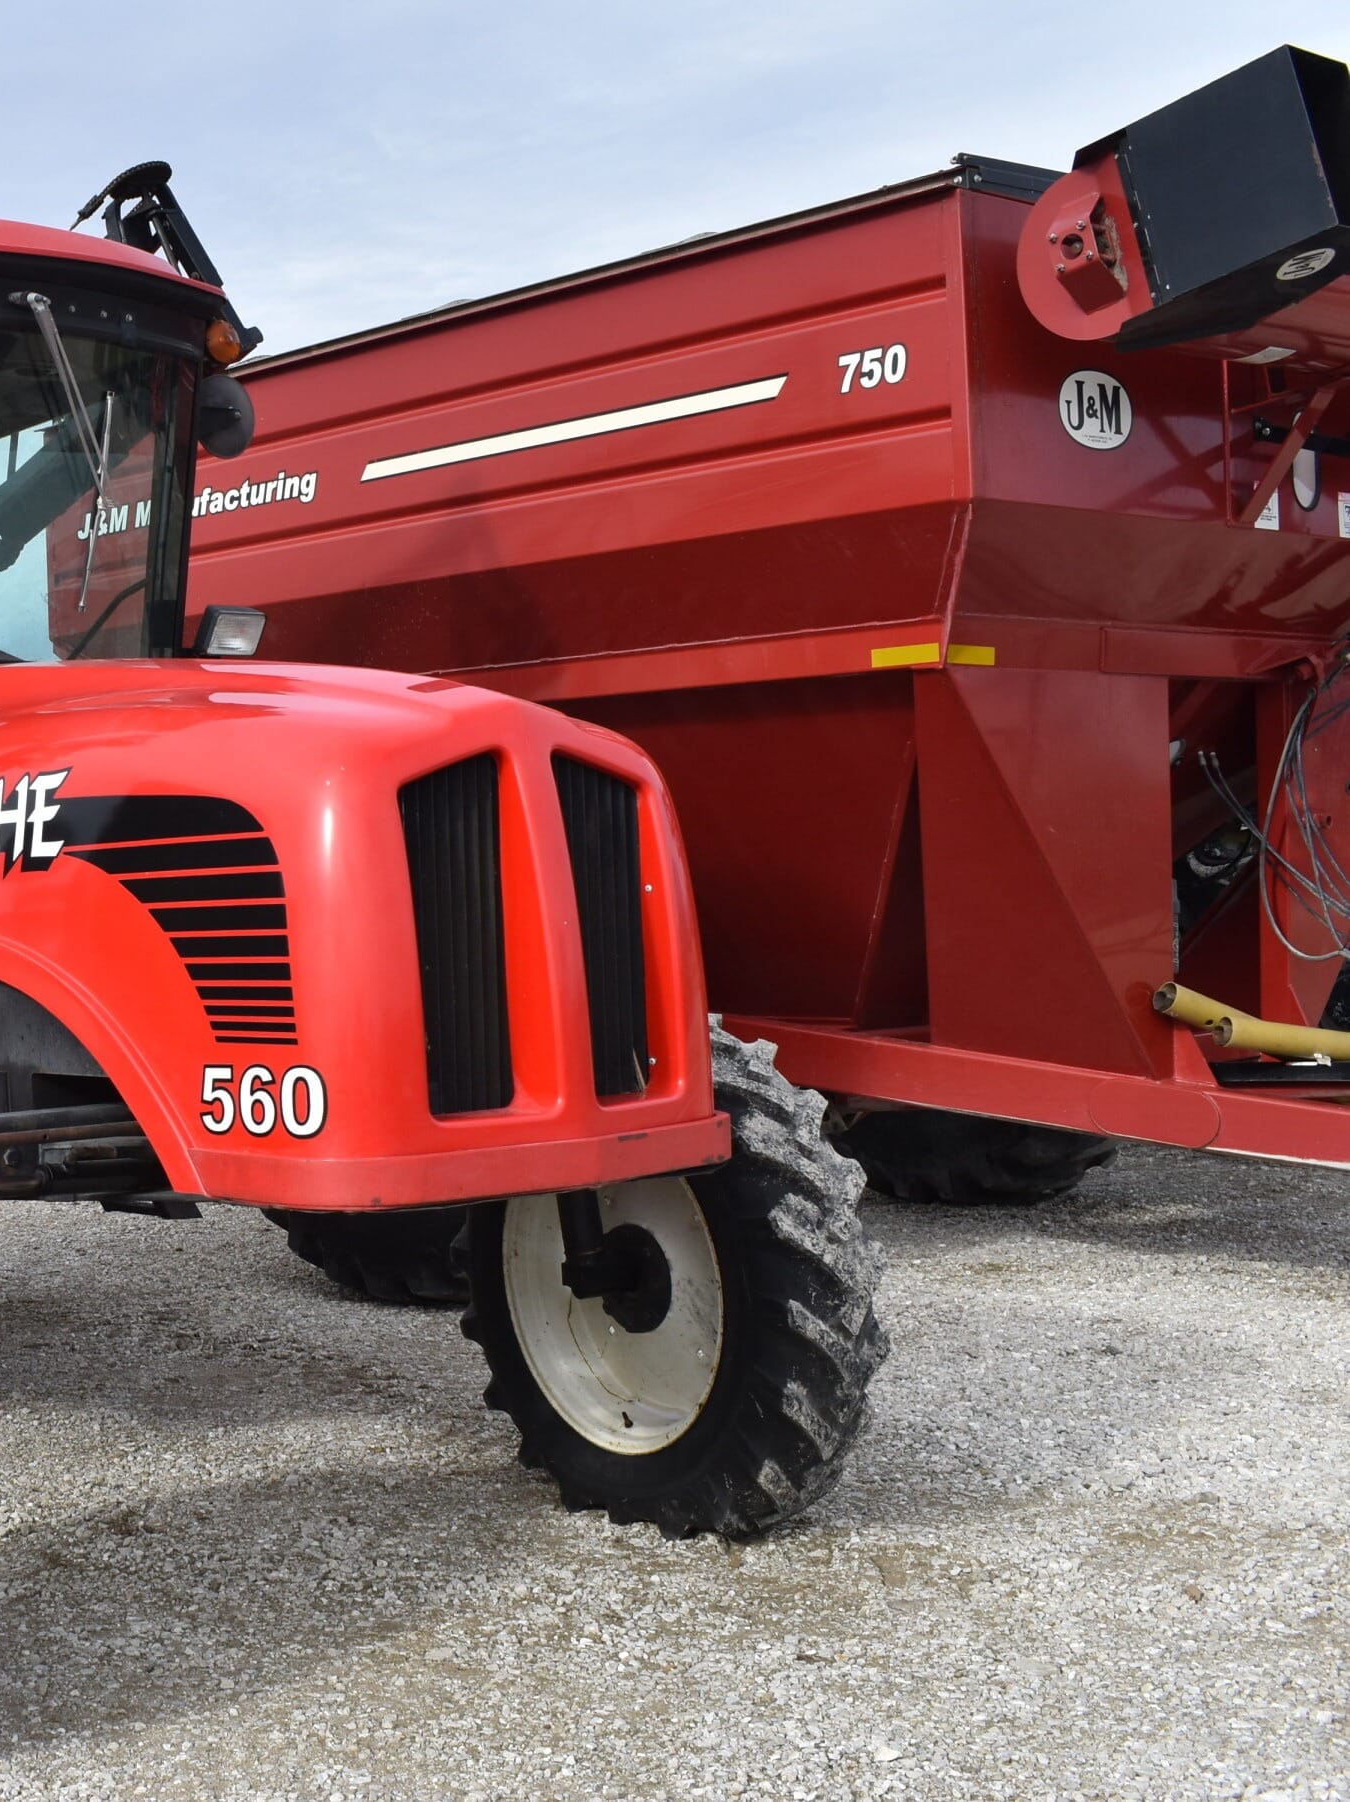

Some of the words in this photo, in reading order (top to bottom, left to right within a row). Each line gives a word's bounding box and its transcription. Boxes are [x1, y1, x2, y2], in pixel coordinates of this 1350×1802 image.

[837, 343, 907, 395] 750
[1064, 379, 1124, 436] J&M
[76, 503, 130, 541] J&M
[199, 1064, 328, 1139] 560
